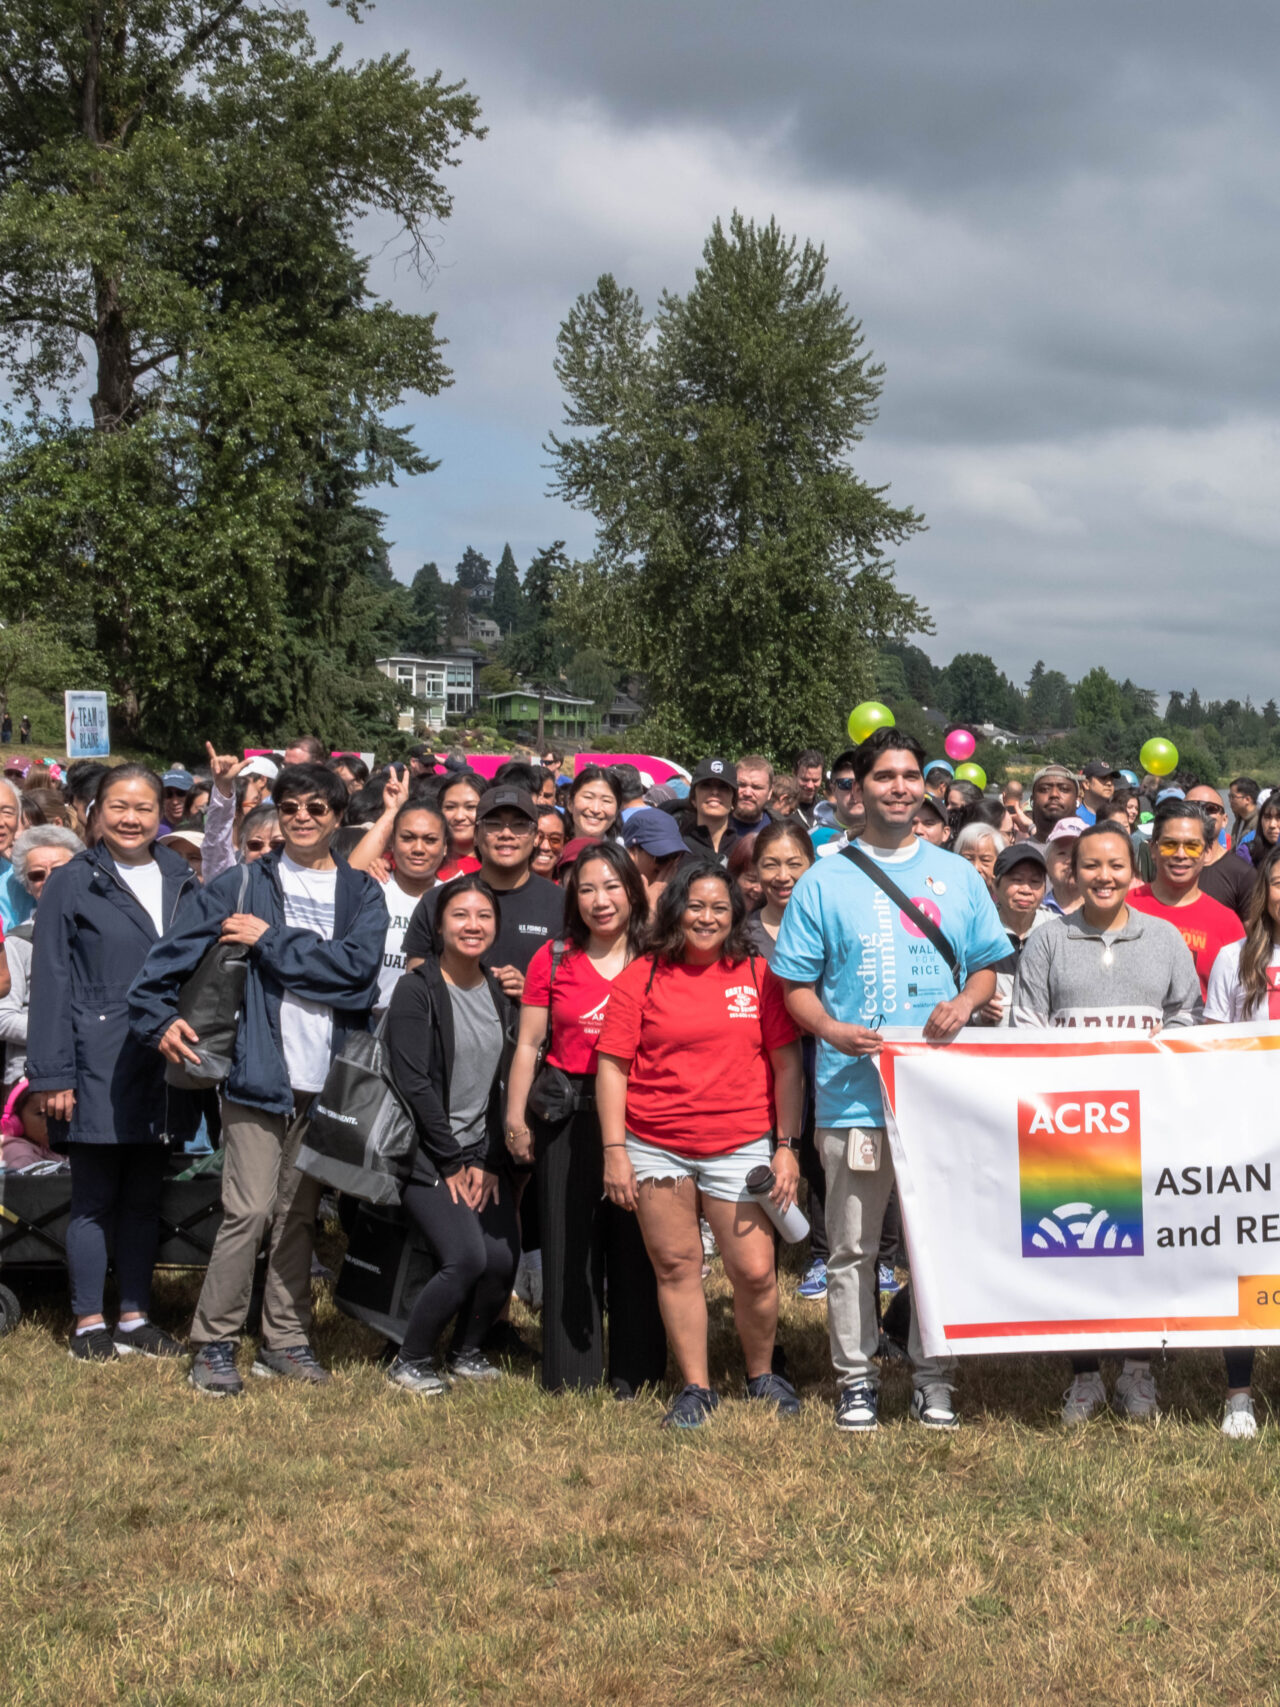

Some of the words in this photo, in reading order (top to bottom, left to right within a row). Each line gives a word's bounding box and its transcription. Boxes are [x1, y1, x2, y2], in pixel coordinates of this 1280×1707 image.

[78, 706, 98, 727] TEAM
[857, 932, 882, 1021] feeding
[911, 965, 940, 975] RICE
[1028, 1101, 1130, 1135] ACRS
[1155, 1162, 1271, 1196] ASIAN
[1156, 1215, 1221, 1248] and
